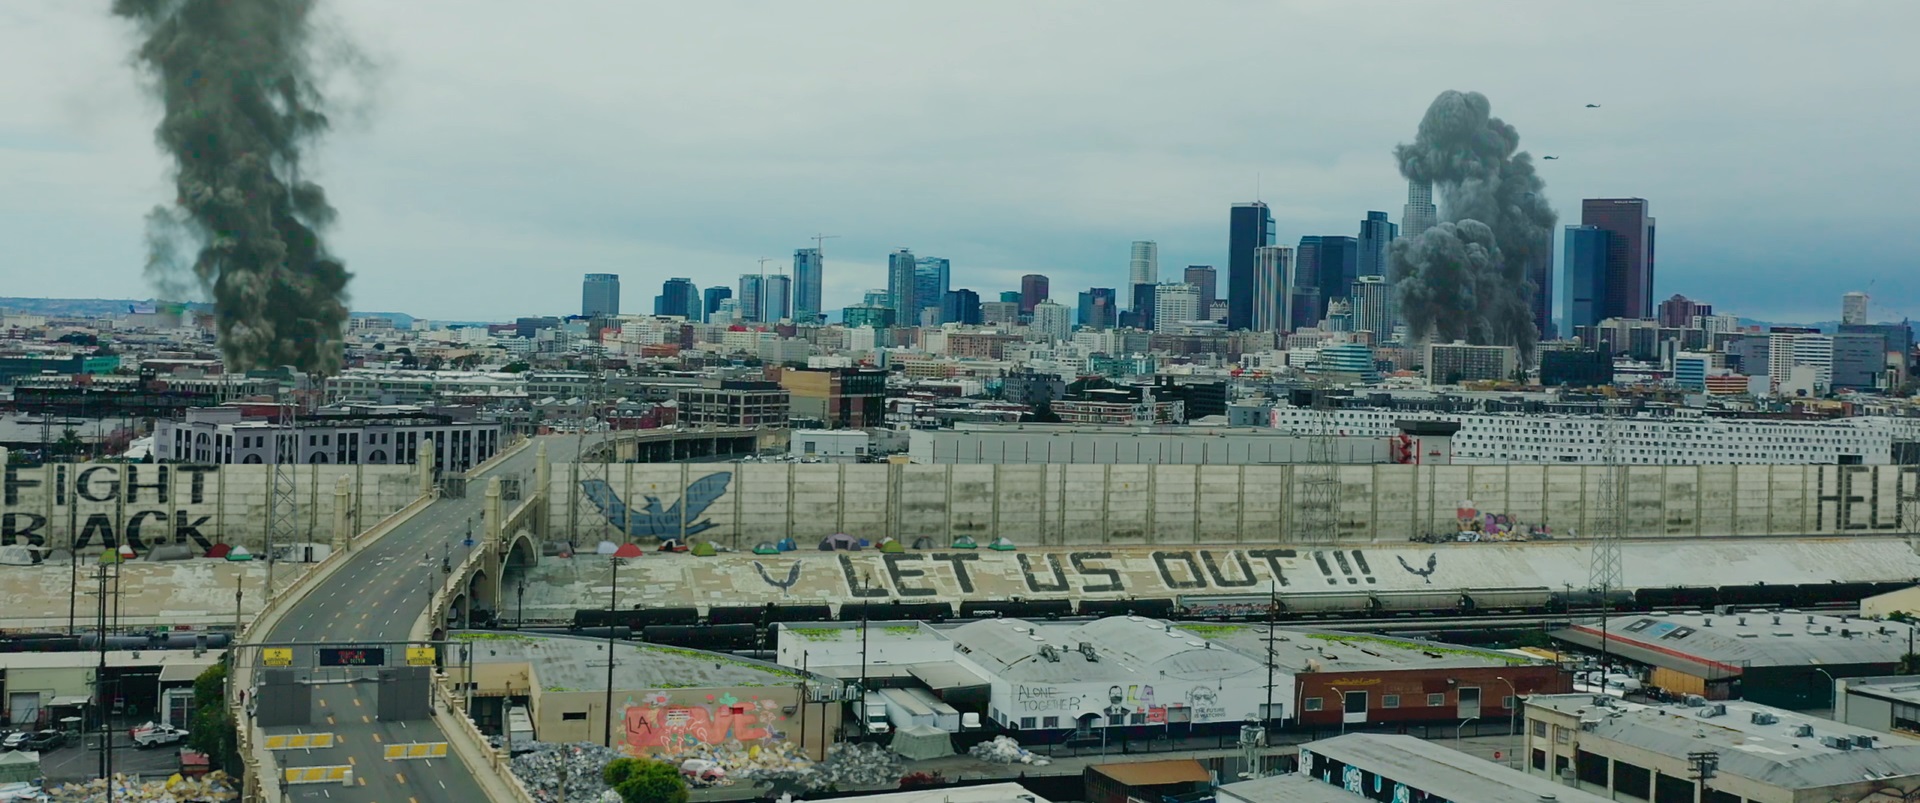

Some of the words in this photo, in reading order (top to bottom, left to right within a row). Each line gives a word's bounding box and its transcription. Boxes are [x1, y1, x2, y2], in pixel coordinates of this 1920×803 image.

[5, 463, 219, 505] FIGHT
[838, 552, 979, 598] LET
[1016, 551, 1125, 592] US
[1018, 684, 1058, 701] ALONE
[1020, 696, 1081, 711] TOGETHER
[628, 716, 652, 735] LA
